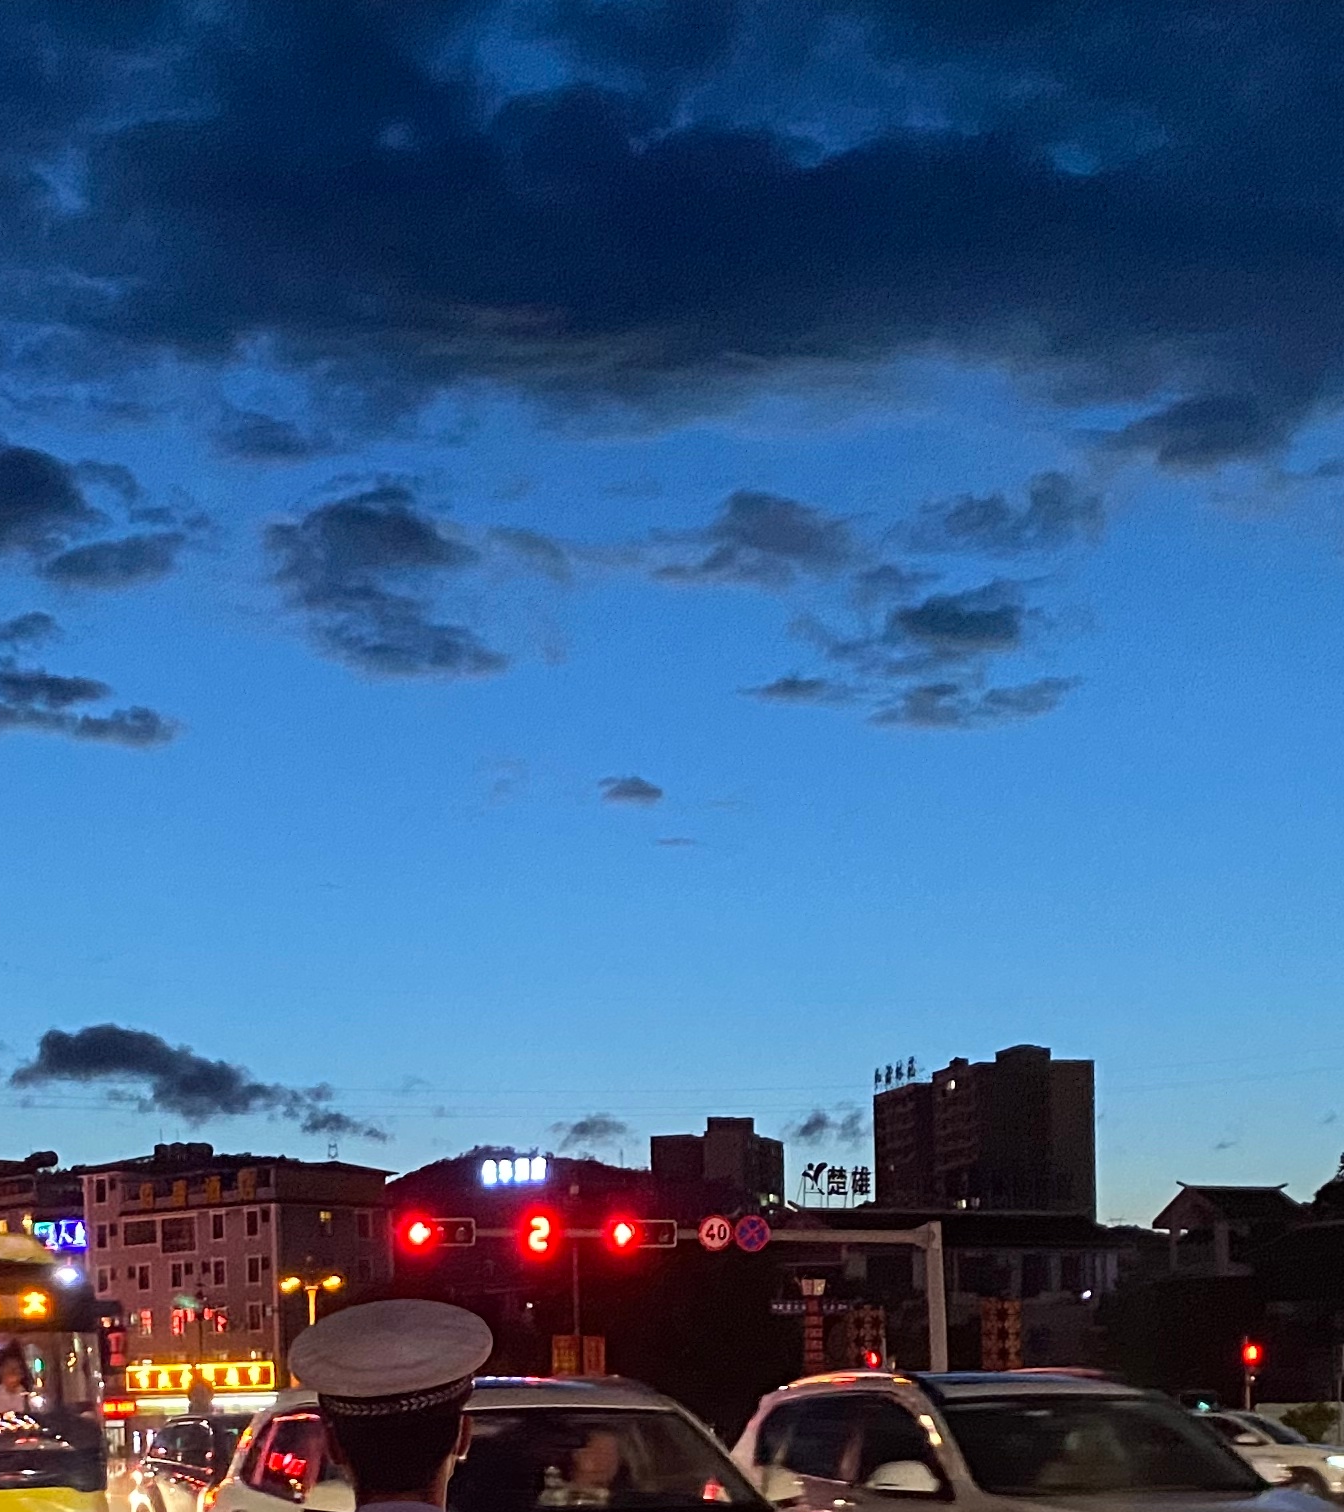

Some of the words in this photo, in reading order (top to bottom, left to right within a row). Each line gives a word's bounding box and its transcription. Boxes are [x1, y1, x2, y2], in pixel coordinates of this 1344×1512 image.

[827, 1165, 872, 1196] 楚雄
[528, 1215, 550, 1253] 2
[705, 1223, 727, 1241] 40
